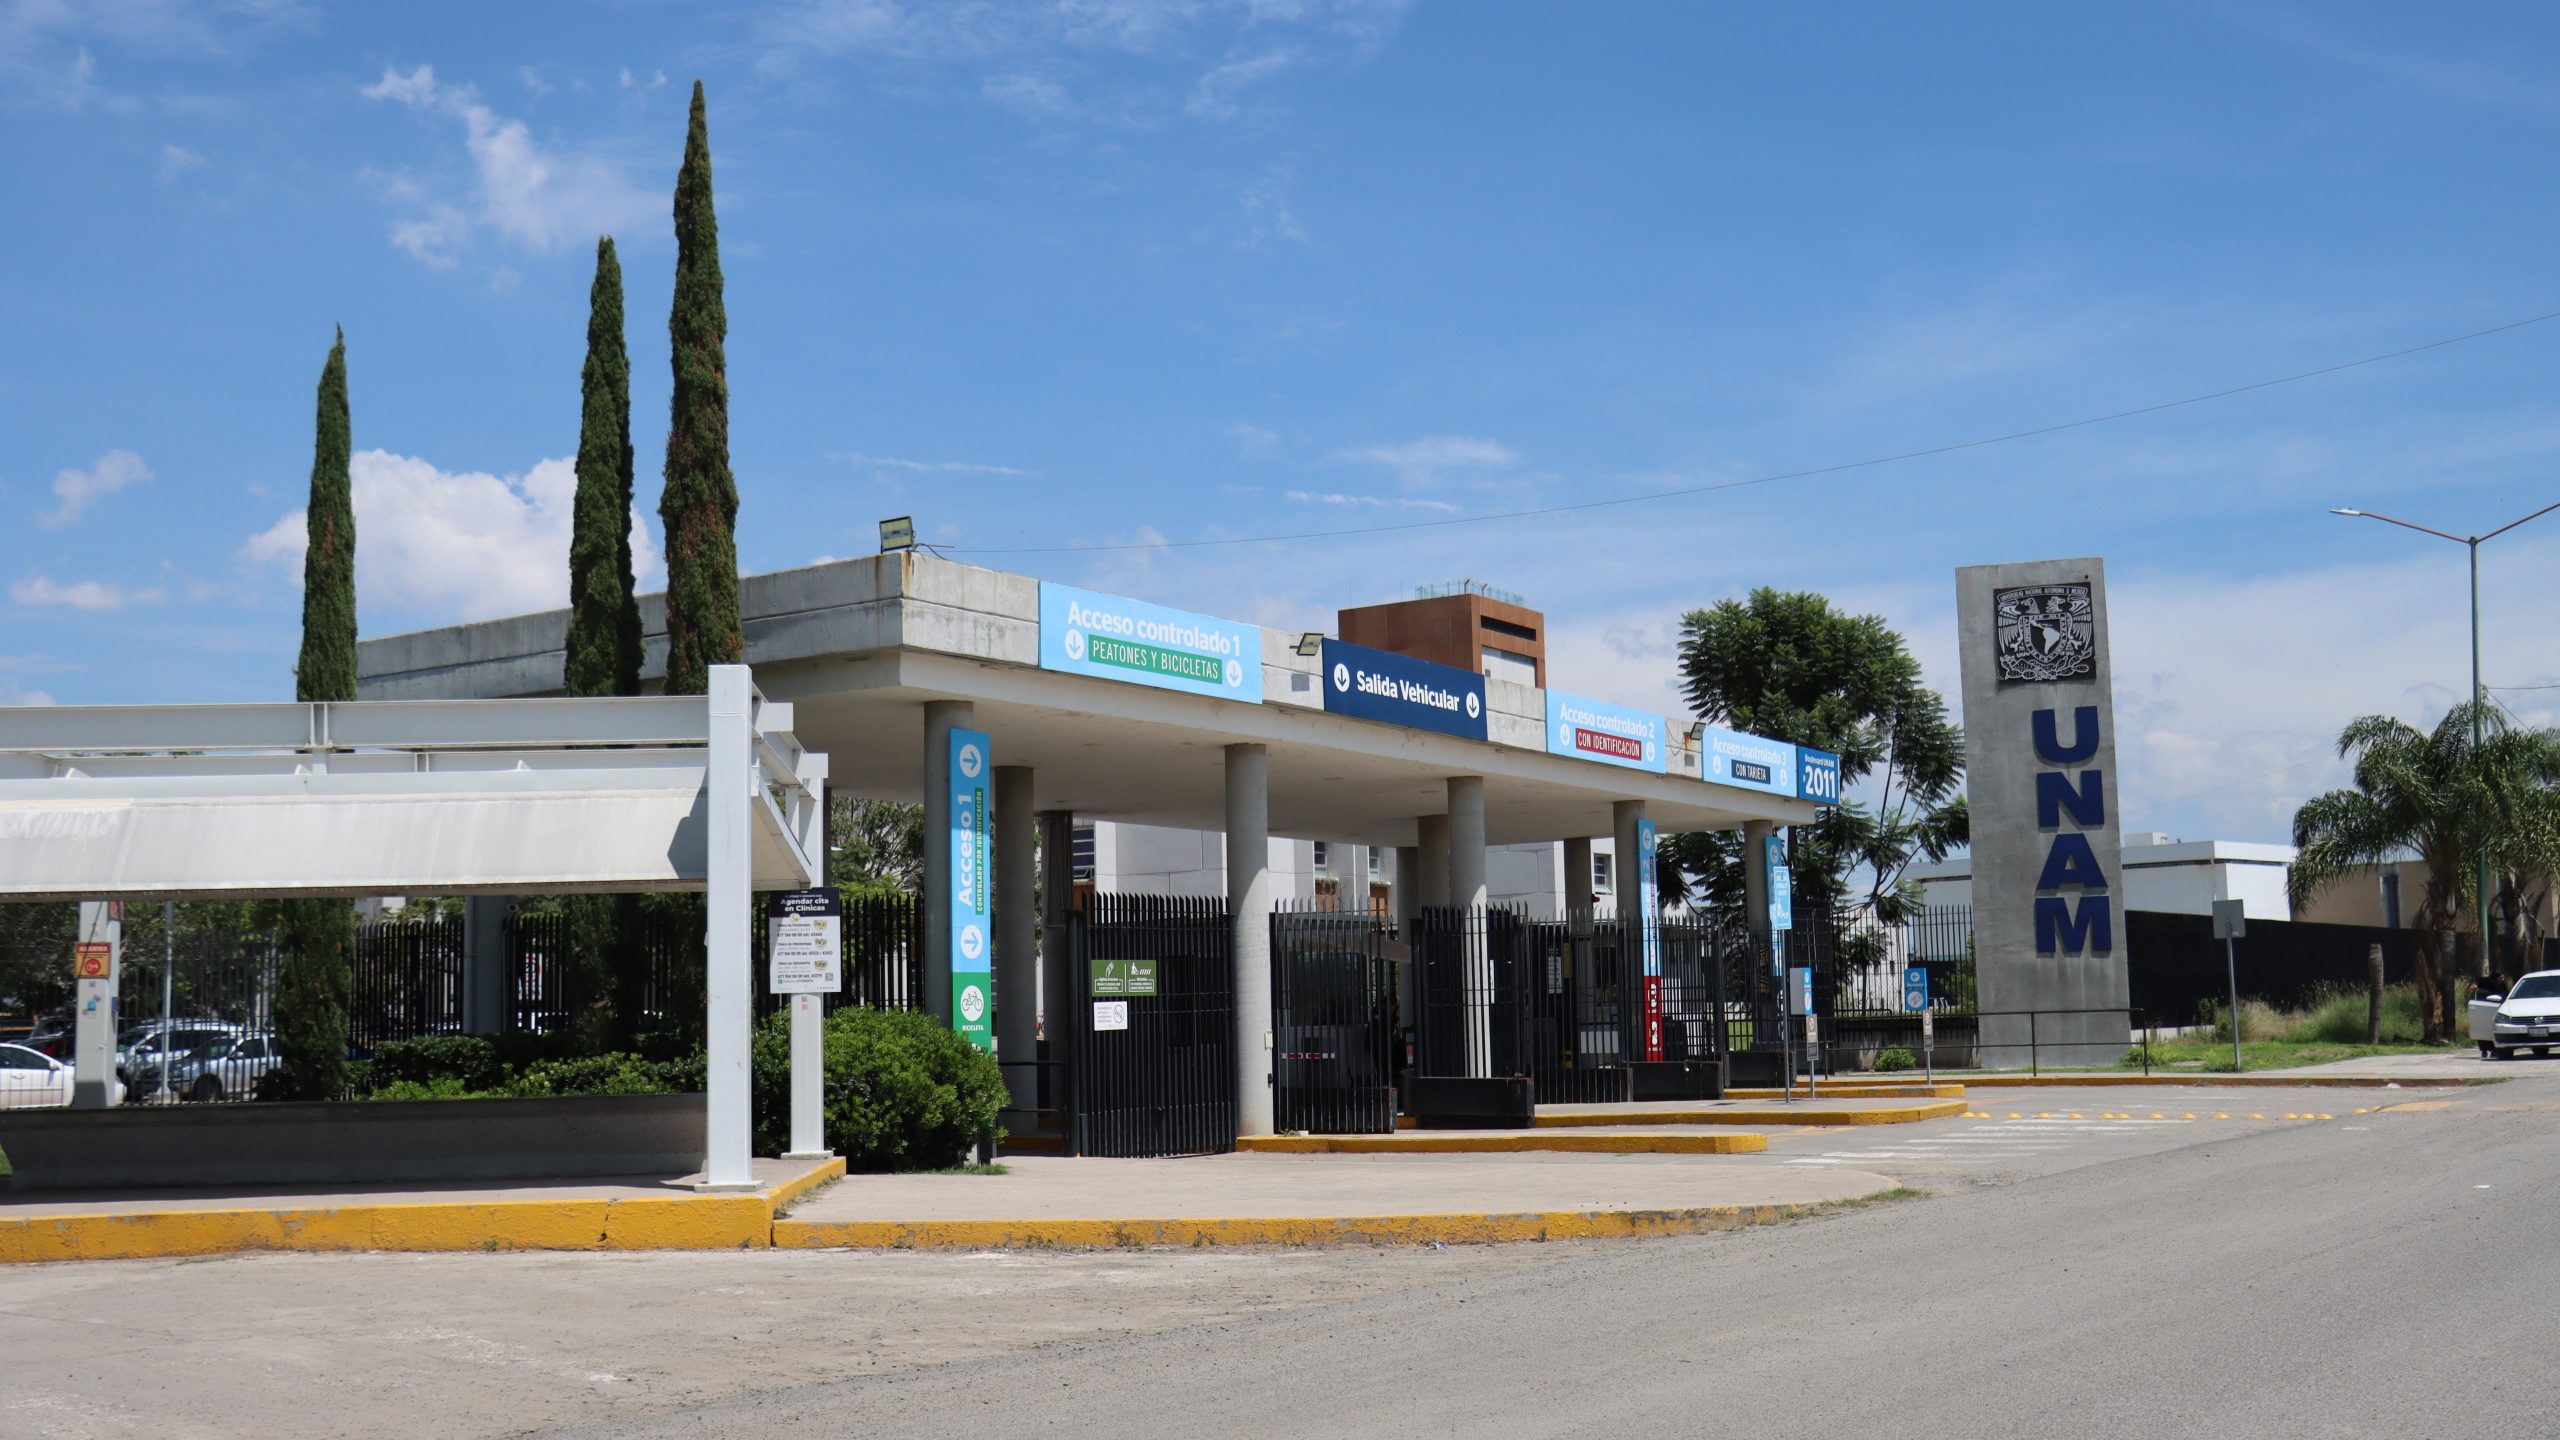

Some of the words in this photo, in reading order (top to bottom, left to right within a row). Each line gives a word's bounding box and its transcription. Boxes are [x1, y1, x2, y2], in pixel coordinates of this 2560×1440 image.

[1067, 601, 1134, 636] Acceso
[1137, 619, 1231, 655] controlado
[1233, 634, 1240, 657] 1
[1092, 640, 1147, 667] PEATONES
[1151, 651, 1157, 668] Y
[1161, 652, 1218, 679] BICICLETAS
[1356, 670, 1398, 699] Salida
[1399, 679, 1460, 712] Vehicular
[1560, 702, 1596, 727] Acceso
[1597, 713, 1648, 738] controlado
[1648, 721, 1655, 739] 2
[1578, 732, 1591, 748] CON
[1592, 735, 1640, 758] IDENTIFICACIÓN
[1713, 736, 1741, 757] Acceso
[1741, 745, 1782, 766] controlado
[1735, 763, 1747, 777] CON
[1747, 765, 1767, 781] TARJETA
[1805, 765, 1836, 799] 2011
[957, 794, 972, 805] 1
[2031, 705, 2113, 953] UNAM
[957, 811, 973, 907] Acceso
[781, 898, 814, 906] Agendar
